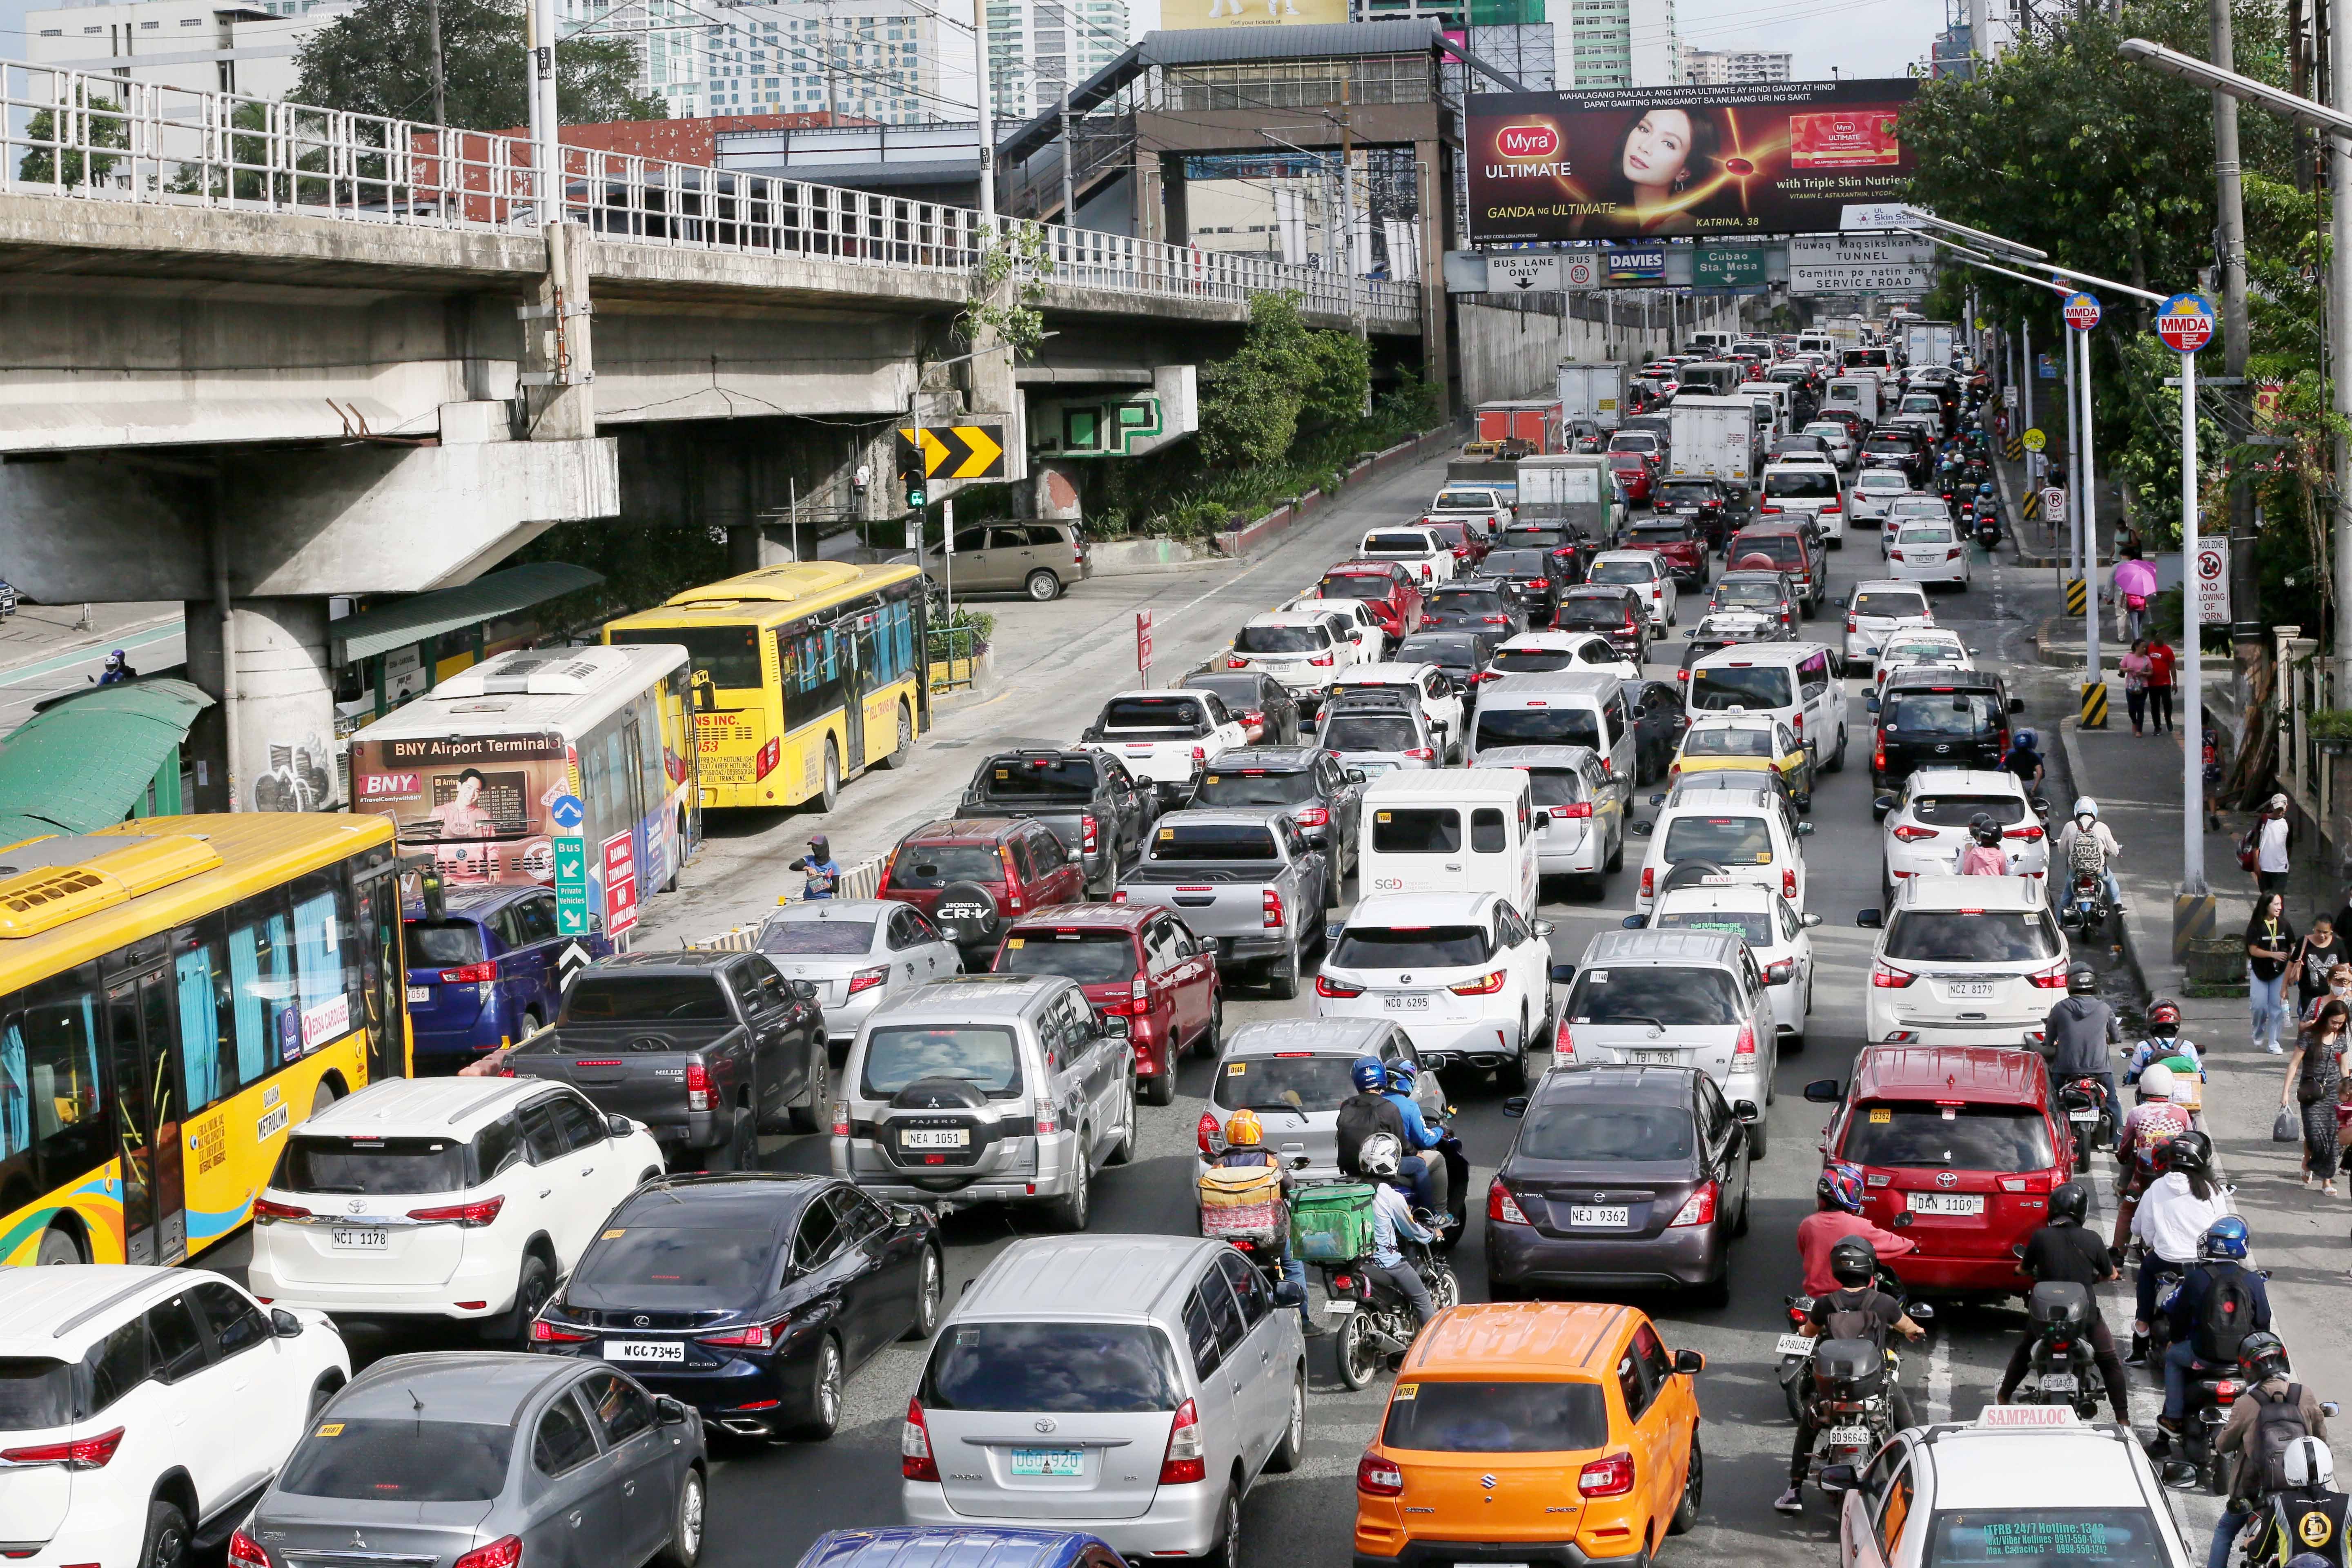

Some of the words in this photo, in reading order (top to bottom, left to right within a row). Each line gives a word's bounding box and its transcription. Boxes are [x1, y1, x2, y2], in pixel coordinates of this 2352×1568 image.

[1559, 91, 1615, 100] MAHALAGANG
[1617, 89, 1653, 98] PAALALA:
[1698, 87, 1735, 95] ULTIMATE
[1772, 85, 1802, 93] GAMOT
[1584, 100, 1609, 109] DAPAT
[1610, 99, 1650, 107] GAMITING
[1651, 98, 1702, 107] PANGGAMOT
[1716, 95, 1756, 104] ANUMANG
[1506, 132, 1549, 151] Myra
[1485, 162, 1571, 178] ULTIMATE
[1777, 178, 1800, 189] with
[1803, 177, 1835, 190] Triple
[1838, 176, 1861, 187] Skin
[1488, 206, 1535, 218] GANDA
[1552, 203, 1616, 215] ULTIMATE
[1696, 217, 1743, 227] KATRINA,
[1747, 217, 1759, 225] 38
[1794, 240, 1831, 250] Huwag
[1838, 239, 1911, 250] Magsiksikan
[1610, 254, 1662, 267] DAVIES
[1708, 252, 1748, 261] Cubao
[1836, 251, 1889, 261] TUNNEL
[1509, 268, 1539, 276] ONLY
[1699, 263, 1722, 272] Sta.
[1727, 263, 1757, 271] Mesa
[1798, 269, 1844, 278] Gamitin
[1852, 270, 1864, 278] po
[1871, 267, 1901, 276] natin
[1908, 268, 1927, 276] ang
[1816, 278, 1873, 288] SERVICE
[1878, 277, 1911, 286] ROAD
[2066, 308, 2098, 317] MMDA
[2161, 318, 2209, 332] MMDA
[2198, 541, 2210, 549] HOOL
[2212, 540, 2223, 548] ZONE
[2201, 583, 2218, 591] NO
[714, 715, 739, 726] INC.
[395, 743, 427, 757] BNY
[431, 739, 482, 757] Airport
[487, 737, 549, 753] Terminal
[367, 774, 413, 794] BNY
[360, 795, 422, 803] #TravelComfywithBNY
[558, 843, 580, 852] Bus
[610, 843, 628, 864] BAWAL
[608, 860, 633, 884] TUMAWID
[1375, 878, 1402, 890] SGD
[617, 885, 627, 907] NO
[610, 904, 637, 929] JAYWALKING
[937, 908, 991, 919] CR-V
[1950, 985, 1966, 993] NCZ
[1972, 985, 1992, 993] 8179
[1386, 998, 1401, 1007] NCQ
[1407, 998, 1428, 1007] 6295
[312, 1016, 325, 1036] EDSA
[325, 1004, 348, 1030] CAROUSEL
[285, 1034, 297, 1047] beep
[1657, 1052, 1674, 1063] 761
[258, 1106, 288, 1140] METROLINK
[911, 1133, 928, 1144] NEA
[935, 1133, 959, 1144] 1051
[1918, 1198, 1938, 1209] DAN
[1945, 1199, 1972, 1211] 1109
[1572, 1210, 1592, 1221] NEJ
[1600, 1210, 1626, 1222] 9362
[334, 1232, 352, 1244] NCI
[361, 1233, 386, 1245] 1178
[650, 1346, 682, 1359] 7345
[1987, 1409, 2066, 1425] SAMPALOC
[1052, 1453, 1078, 1468] 920
[2014, 1523, 2036, 1534] 24/7
[2039, 1522, 2079, 1534] Hotline:
[2080, 1523, 2105, 1534] 1342
[2055, 1534, 2106, 1545] 0917-550-1342
[1986, 1546, 2004, 1555] Max.
[2005, 1545, 2038, 1555] Capacity
[2039, 1544, 2044, 1553] 5
